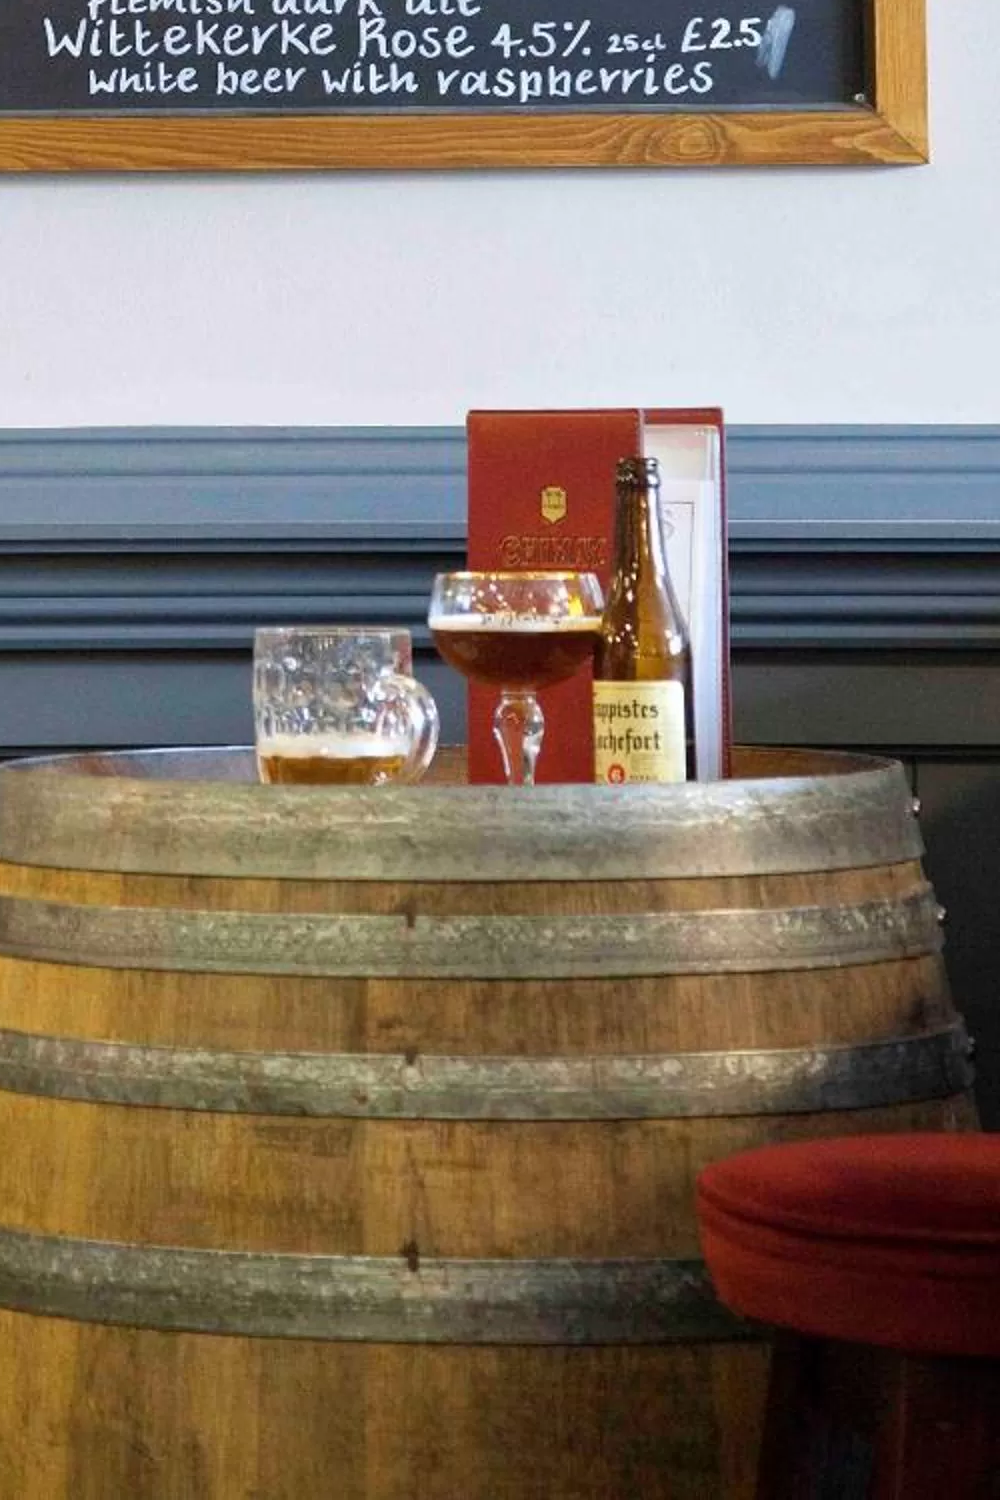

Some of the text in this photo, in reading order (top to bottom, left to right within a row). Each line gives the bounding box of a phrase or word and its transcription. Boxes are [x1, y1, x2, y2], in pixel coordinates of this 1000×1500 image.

[44, 18, 336, 57] Wittekerke
[217, 53, 713, 102] beer raspberries
